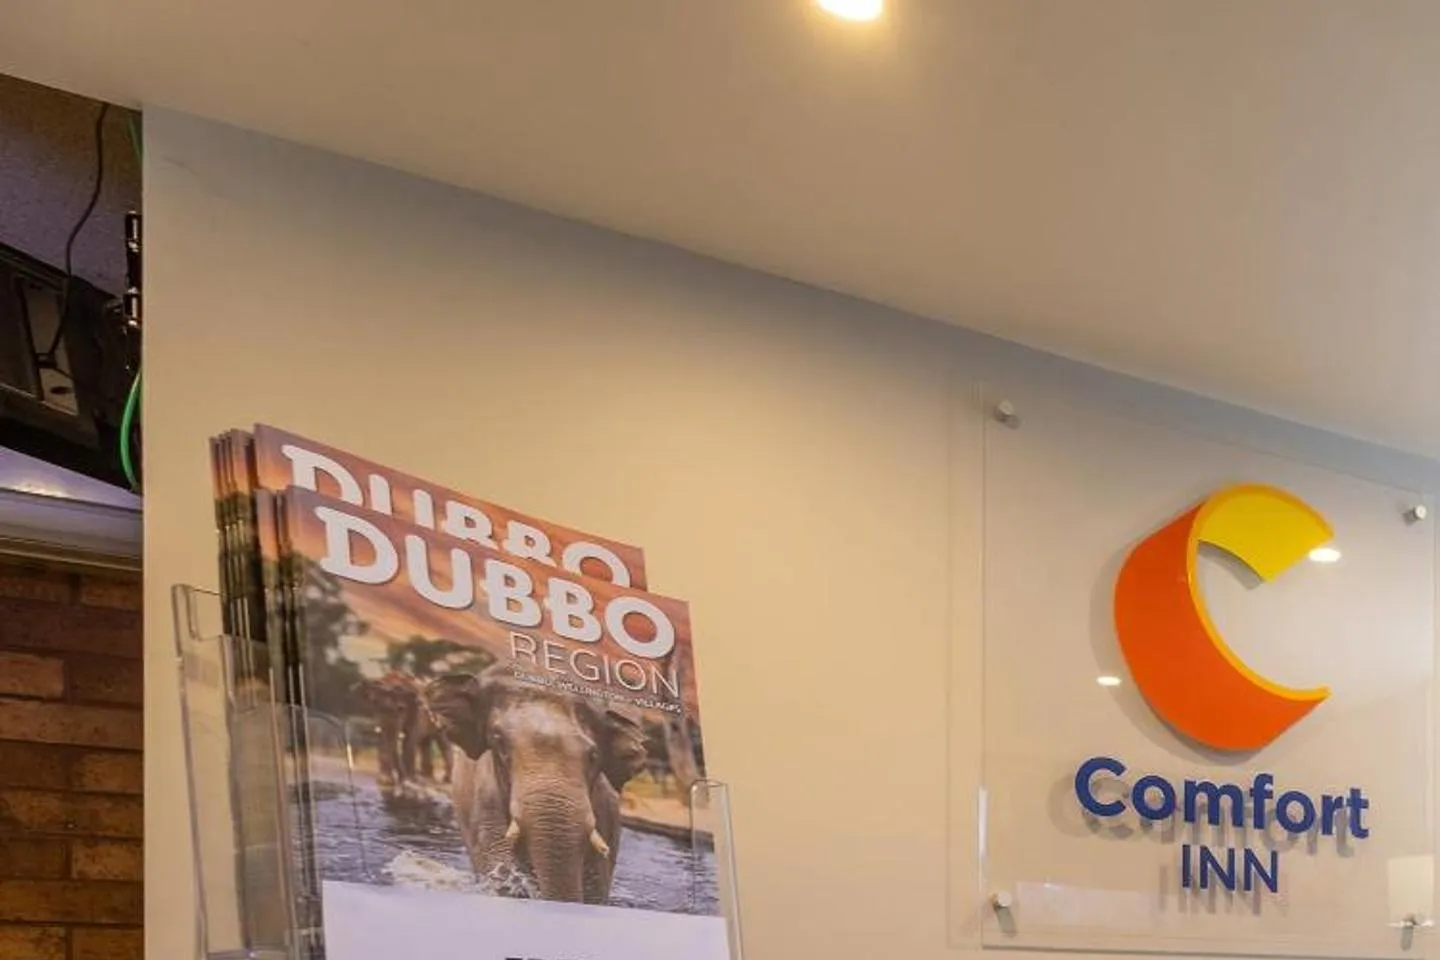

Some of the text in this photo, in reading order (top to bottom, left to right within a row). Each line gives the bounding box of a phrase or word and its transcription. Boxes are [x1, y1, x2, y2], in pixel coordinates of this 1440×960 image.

[314, 505, 676, 659] DUBBO
[509, 630, 681, 699] REGION
[1074, 756, 1370, 839] Comfort
[1181, 844, 1279, 893] INN
